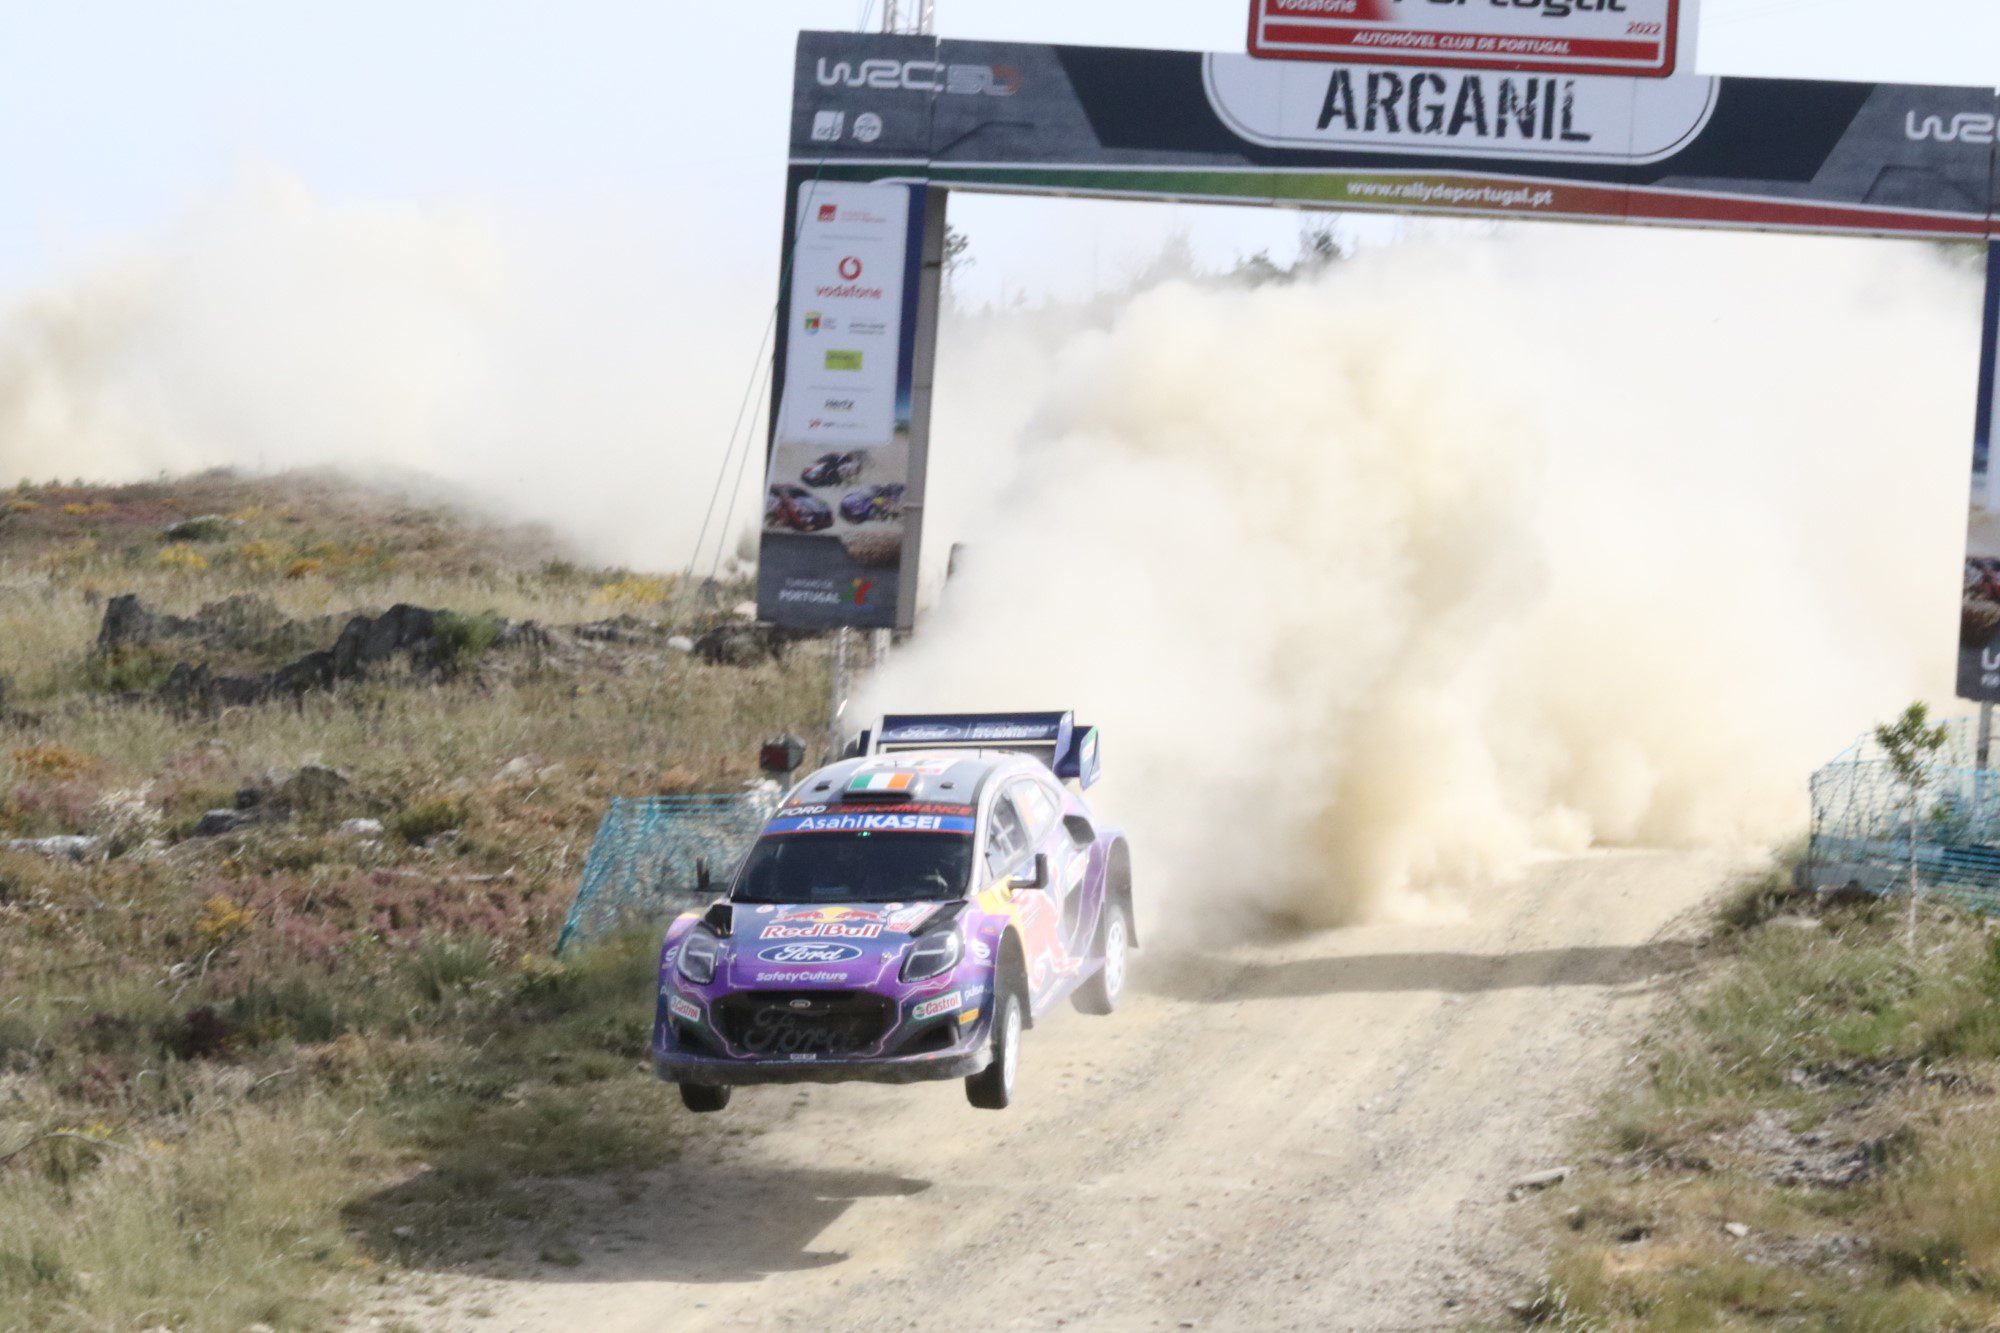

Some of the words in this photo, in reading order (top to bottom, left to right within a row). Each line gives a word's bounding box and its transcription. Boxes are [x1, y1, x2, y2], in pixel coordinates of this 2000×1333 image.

[1624, 21, 1661, 35] 2022
[1352, 32, 1436, 48] AUTOMÓVEL
[1439, 36, 1475, 49] CLUB
[1477, 38, 1496, 50] DE
[1498, 39, 1570, 54] PORTUGAL
[817, 57, 945, 92] WRC
[1316, 68, 1592, 142] ARGANIL
[1905, 110, 2000, 144] WR
[1347, 181, 1553, 206] www.rallydeportugal.pt
[779, 805, 827, 817] FORD
[760, 924, 822, 939] Red
[822, 924, 883, 938] Bull
[774, 944, 846, 962] Ford
[925, 995, 959, 1016] Castrol
